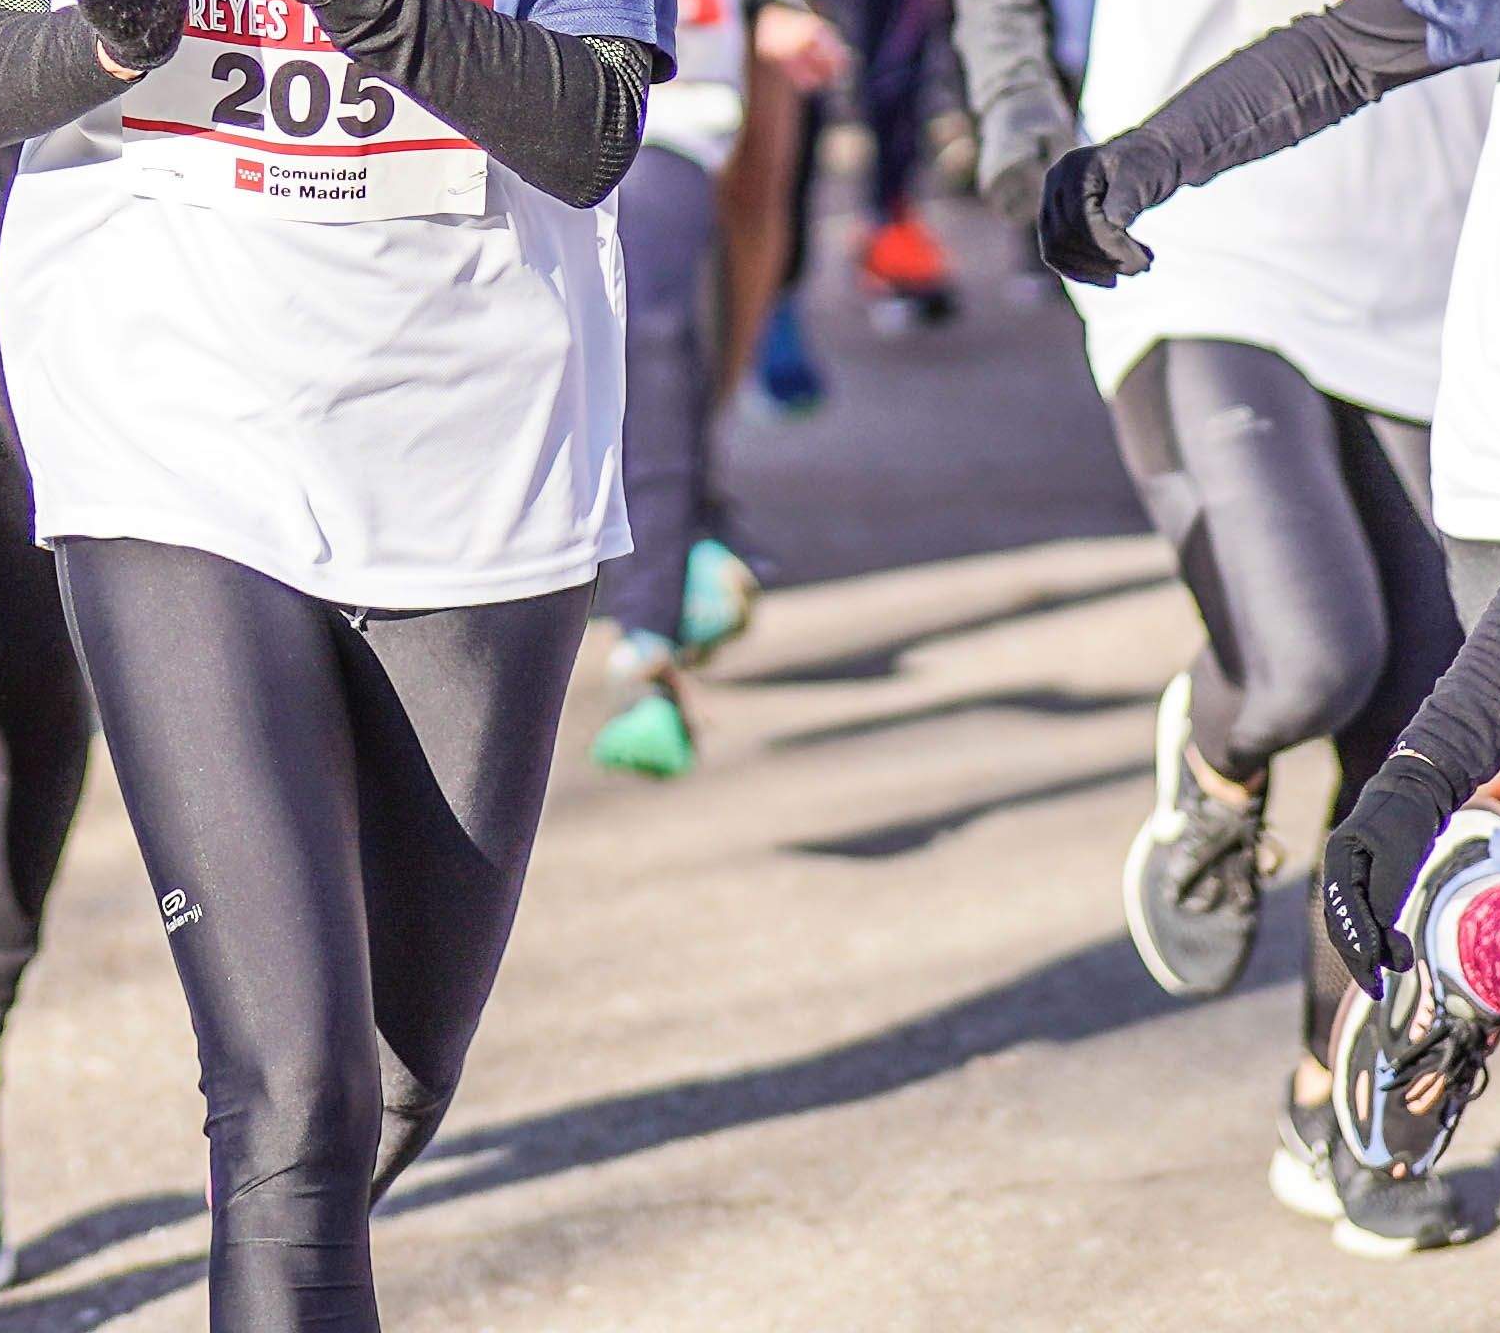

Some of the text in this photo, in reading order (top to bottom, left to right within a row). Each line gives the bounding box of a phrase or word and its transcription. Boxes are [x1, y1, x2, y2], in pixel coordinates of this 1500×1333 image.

[211, 52, 395, 139] 205
[269, 166, 367, 182] Comunidad
[269, 184, 367, 200] de Madrid
[1328, 881, 1361, 954] KIPSTA
